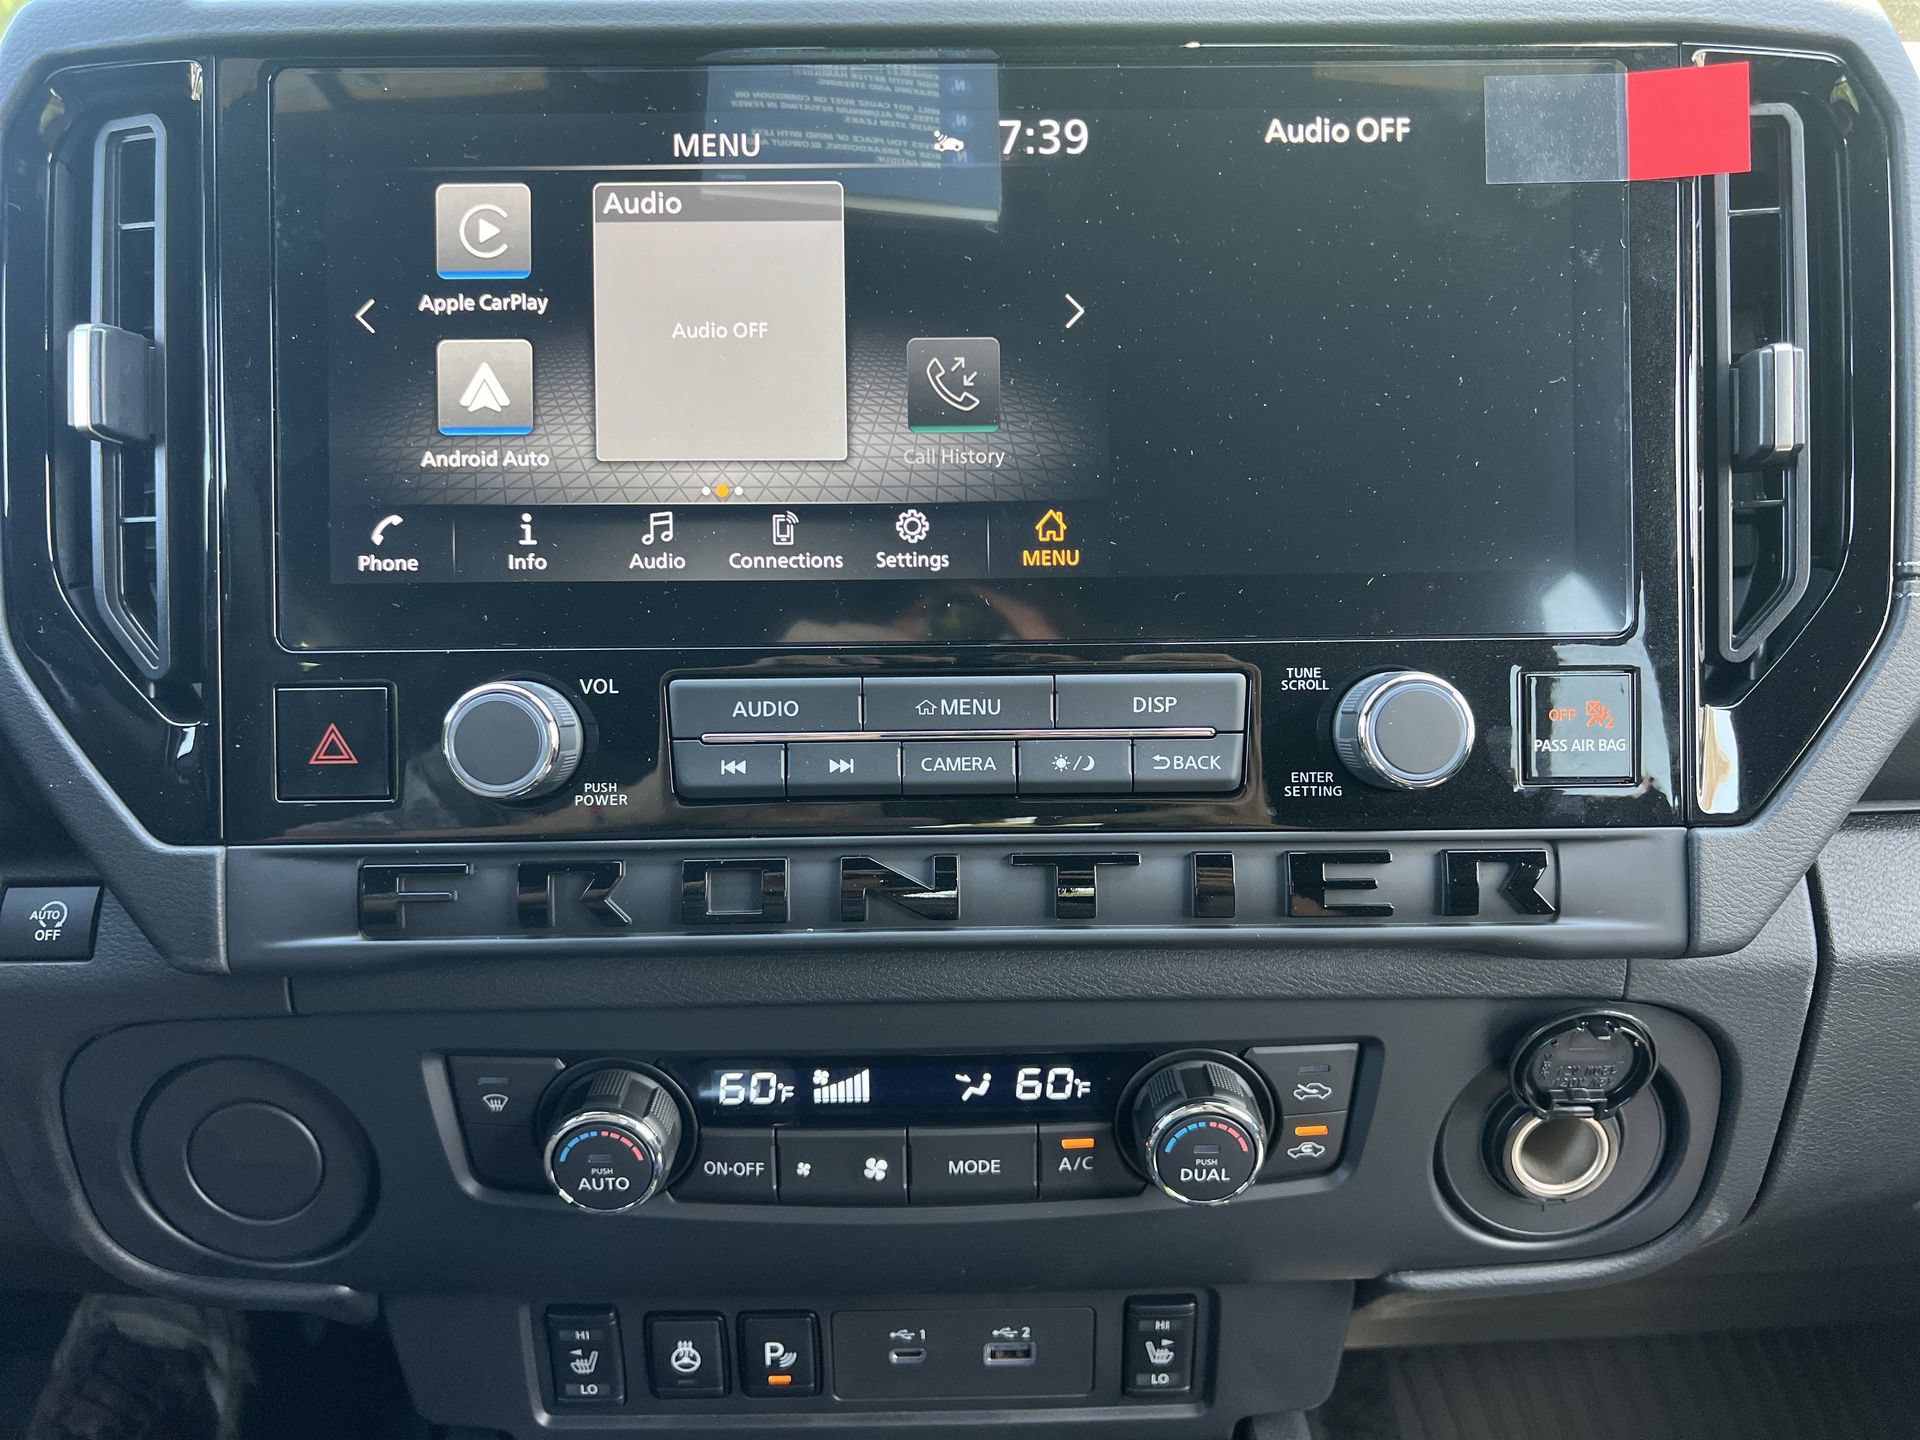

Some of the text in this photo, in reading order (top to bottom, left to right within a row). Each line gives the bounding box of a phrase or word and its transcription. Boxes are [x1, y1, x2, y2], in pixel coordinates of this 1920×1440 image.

[998, 118, 1089, 156] 7:39
[1264, 116, 1411, 144] Audio OFF
[673, 132, 761, 158] MENU
[602, 191, 682, 216] Audio
[419, 292, 549, 315] Apple CarPlay
[671, 321, 769, 339] Audio OFF
[420, 450, 550, 468] Android Auto
[904, 447, 1005, 468] Call History
[357, 555, 419, 573] Phone
[507, 552, 548, 571] Info
[629, 552, 686, 571] Audio
[728, 551, 844, 570] Connections
[875, 550, 950, 572] Settings
[1021, 548, 1081, 568] MENU
[1286, 667, 1321, 679] TUNE
[579, 678, 619, 696] VOL
[1281, 679, 1330, 692] SCROLL
[732, 700, 800, 719] AUDIO
[940, 697, 1001, 716] MENU
[1132, 695, 1178, 714] DISP
[1548, 707, 1576, 722] OFF
[1534, 738, 1626, 752] PASS AIR BAG
[920, 755, 998, 773] CAMERA
[1173, 753, 1222, 771] BACK
[1291, 771, 1334, 784] ENTER
[584, 782, 617, 794] PUSH
[1284, 785, 1342, 798] SETTING
[574, 794, 629, 807] POWER
[360, 849, 1557, 932] FRONTIER
[29, 910, 61, 921] AUTO
[34, 929, 62, 942] OFF
[948, 1158, 1001, 1176] MODE
[1058, 1154, 1094, 1173] A/C
[1195, 1158, 1218, 1166] PUSH
[591, 1167, 614, 1176] PUSH
[1179, 1167, 1230, 1183] DUAL
[578, 1176, 631, 1193] AUTO
[1021, 1326, 1031, 1338] 2
[1155, 1319, 1171, 1331] HI
[575, 1330, 590, 1341] HI
[919, 1328, 927, 1341] 1
[1151, 1373, 1170, 1385] LO
[580, 1384, 598, 1396] LO
